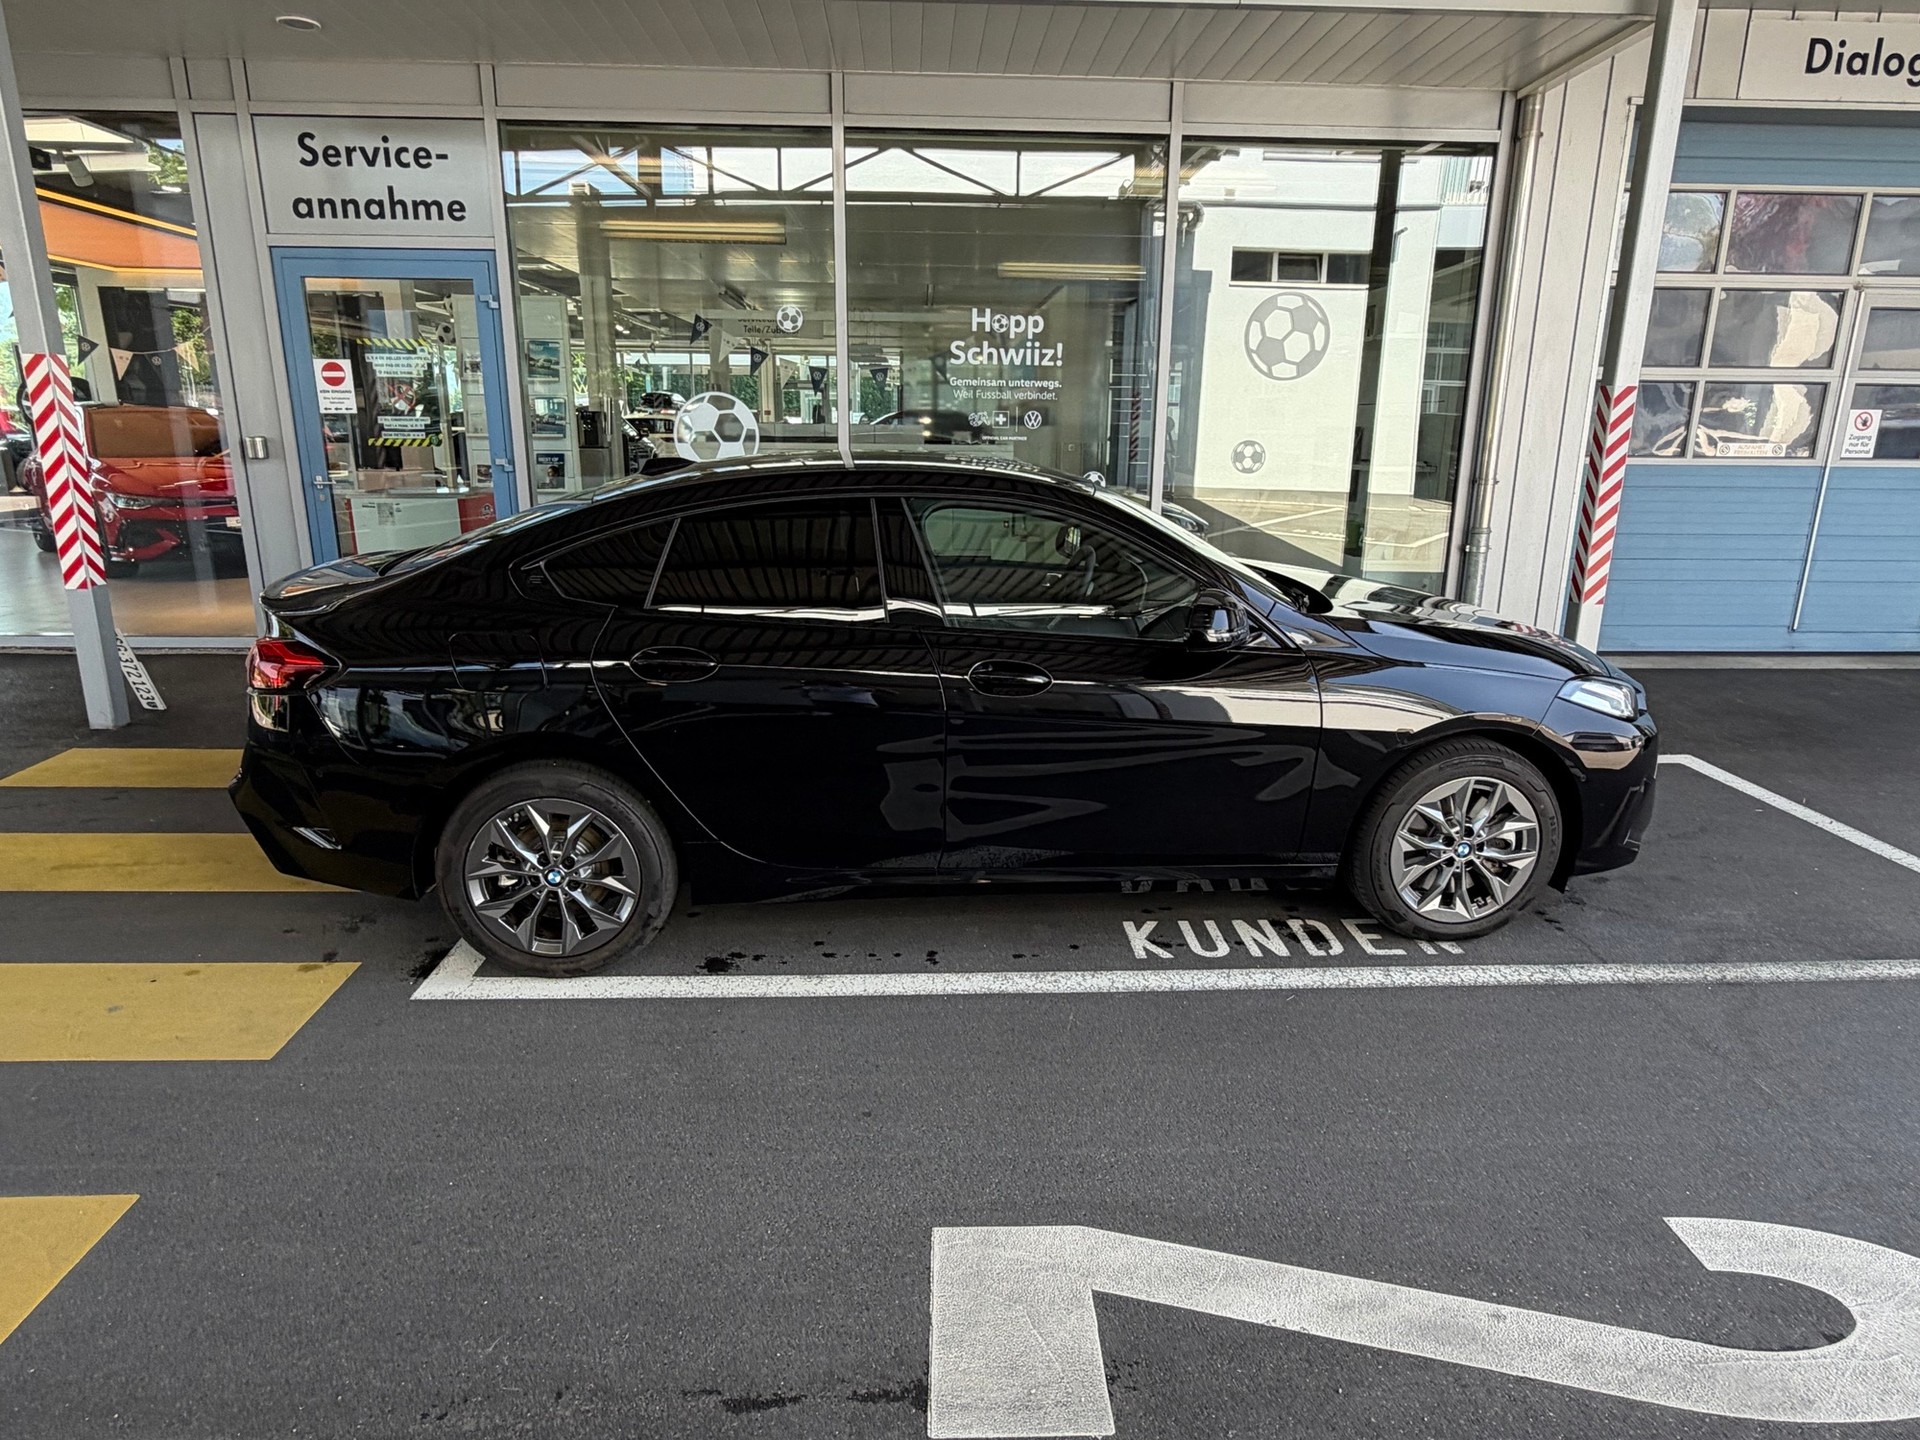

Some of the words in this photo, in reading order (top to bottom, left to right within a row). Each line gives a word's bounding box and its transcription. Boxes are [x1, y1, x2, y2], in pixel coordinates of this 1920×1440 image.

[297, 131, 449, 169] Service-
[292, 185, 467, 222] annahme
[950, 340, 1063, 367] Schwiiz!
[949, 377, 1007, 387] Gemeinsam
[1008, 379, 1062, 390] unterwegs.
[953, 389, 974, 399] Weil
[975, 389, 1012, 399] Fussball
[1014, 391, 1058, 401] verbindet.
